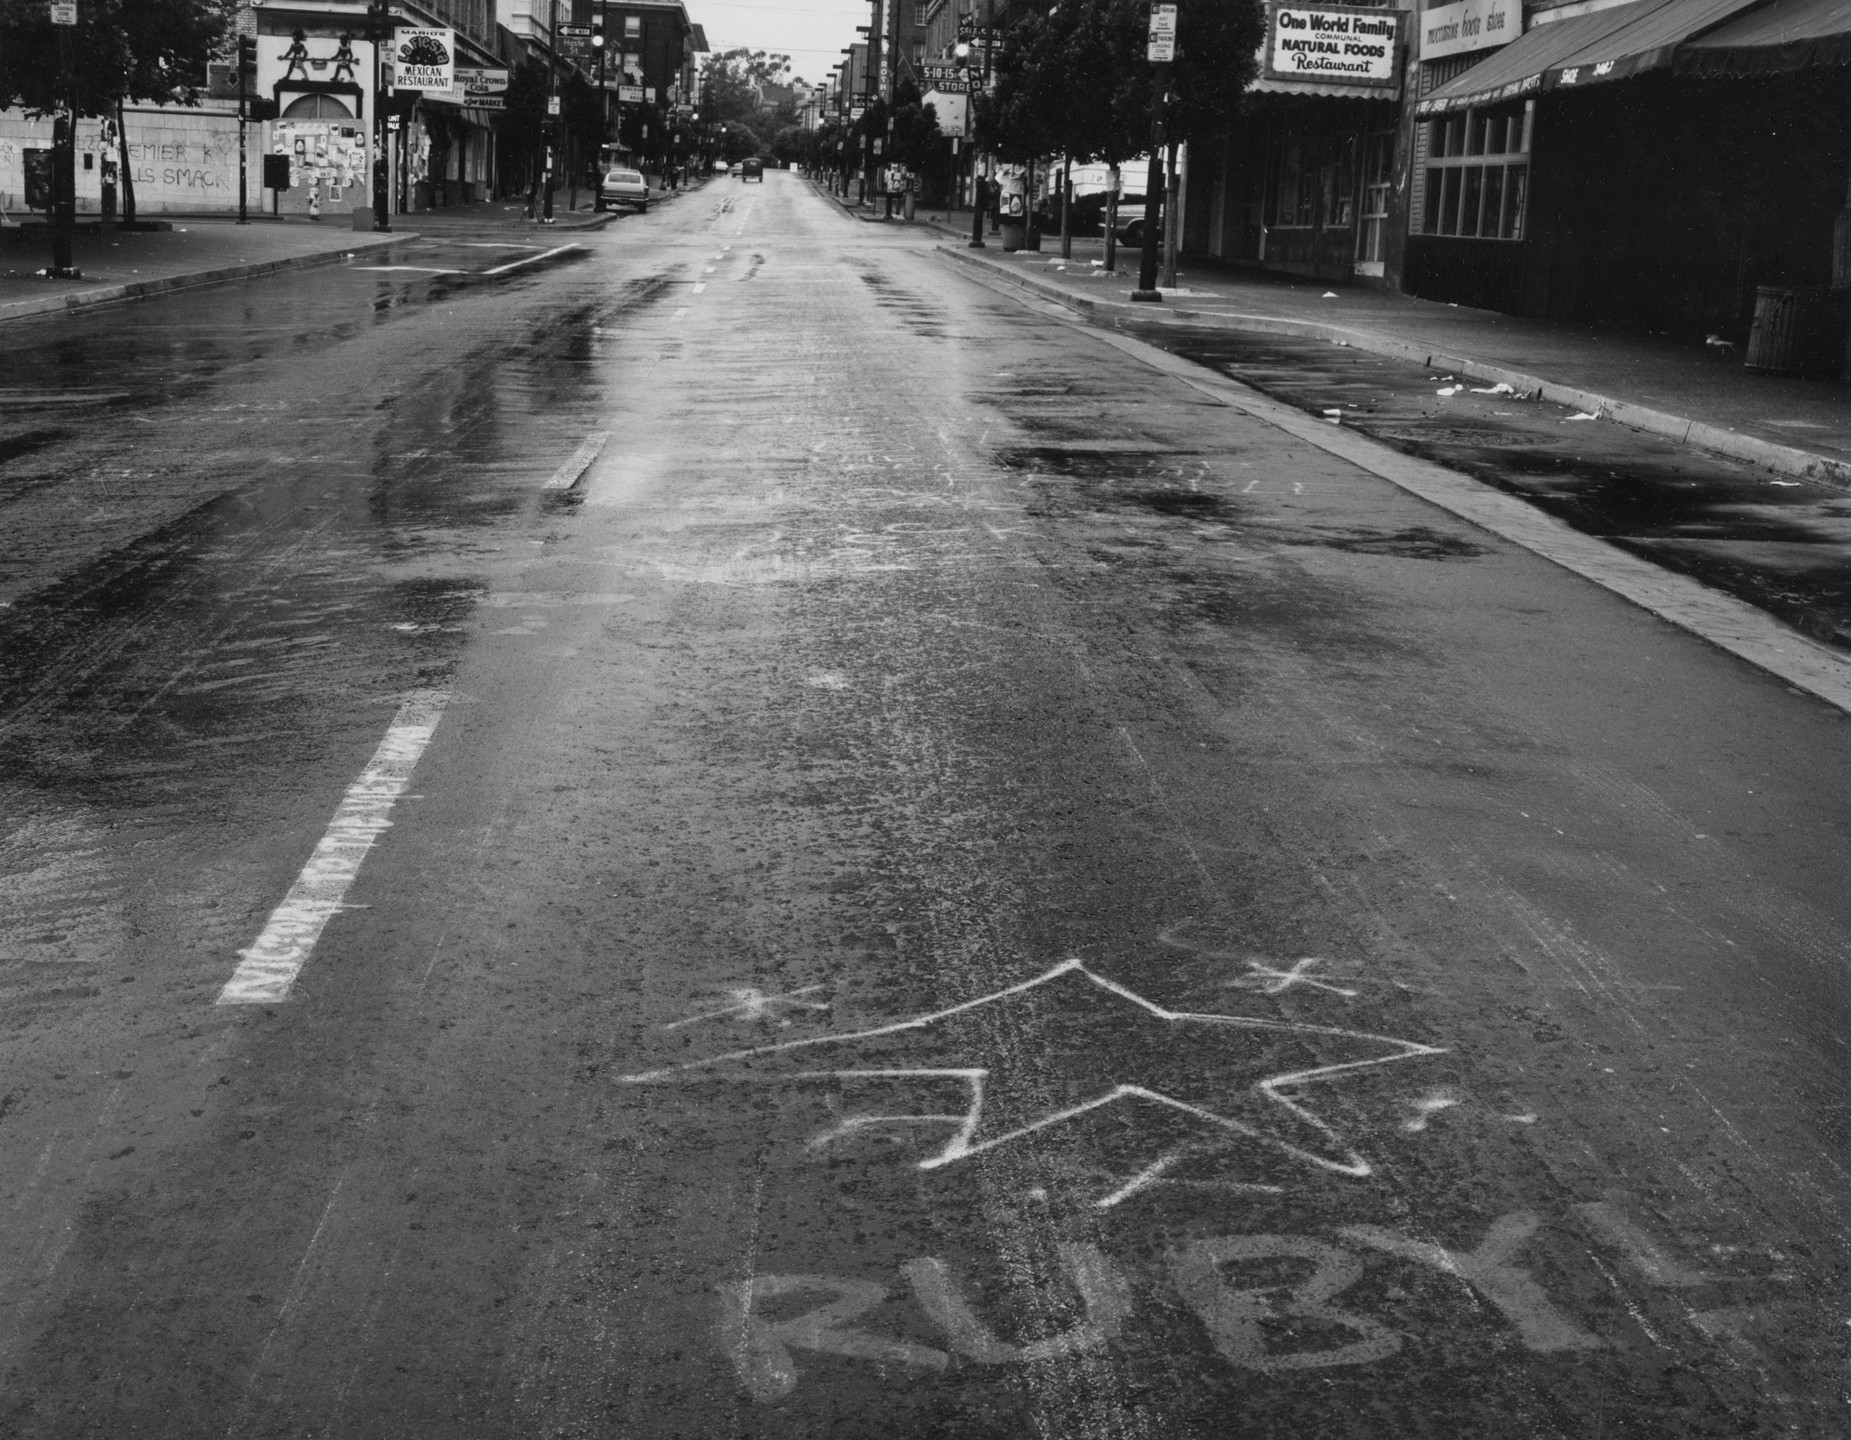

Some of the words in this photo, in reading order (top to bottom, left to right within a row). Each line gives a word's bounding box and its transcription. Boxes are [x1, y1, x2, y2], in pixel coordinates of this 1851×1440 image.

[1279, 12, 1307, 30] One
[1309, 14, 1350, 33] World
[1352, 18, 1395, 41] Family
[1462, 9, 1480, 38] boots
[1314, 32, 1363, 43] COMMUNAL
[1281, 39, 1341, 55] NATURAL
[1343, 44, 1386, 58] FOODS
[1291, 52, 1374, 73] Restaurant
[404, 66, 442, 77] MEXICAN
[397, 76, 449, 88] RESTAURANT
[453, 74, 478, 86] Royal
[480, 76, 508, 86] Crown
[470, 83, 490, 93] Cola
[939, 82, 971, 93] STORE
[162, 167, 230, 191] SMACK
